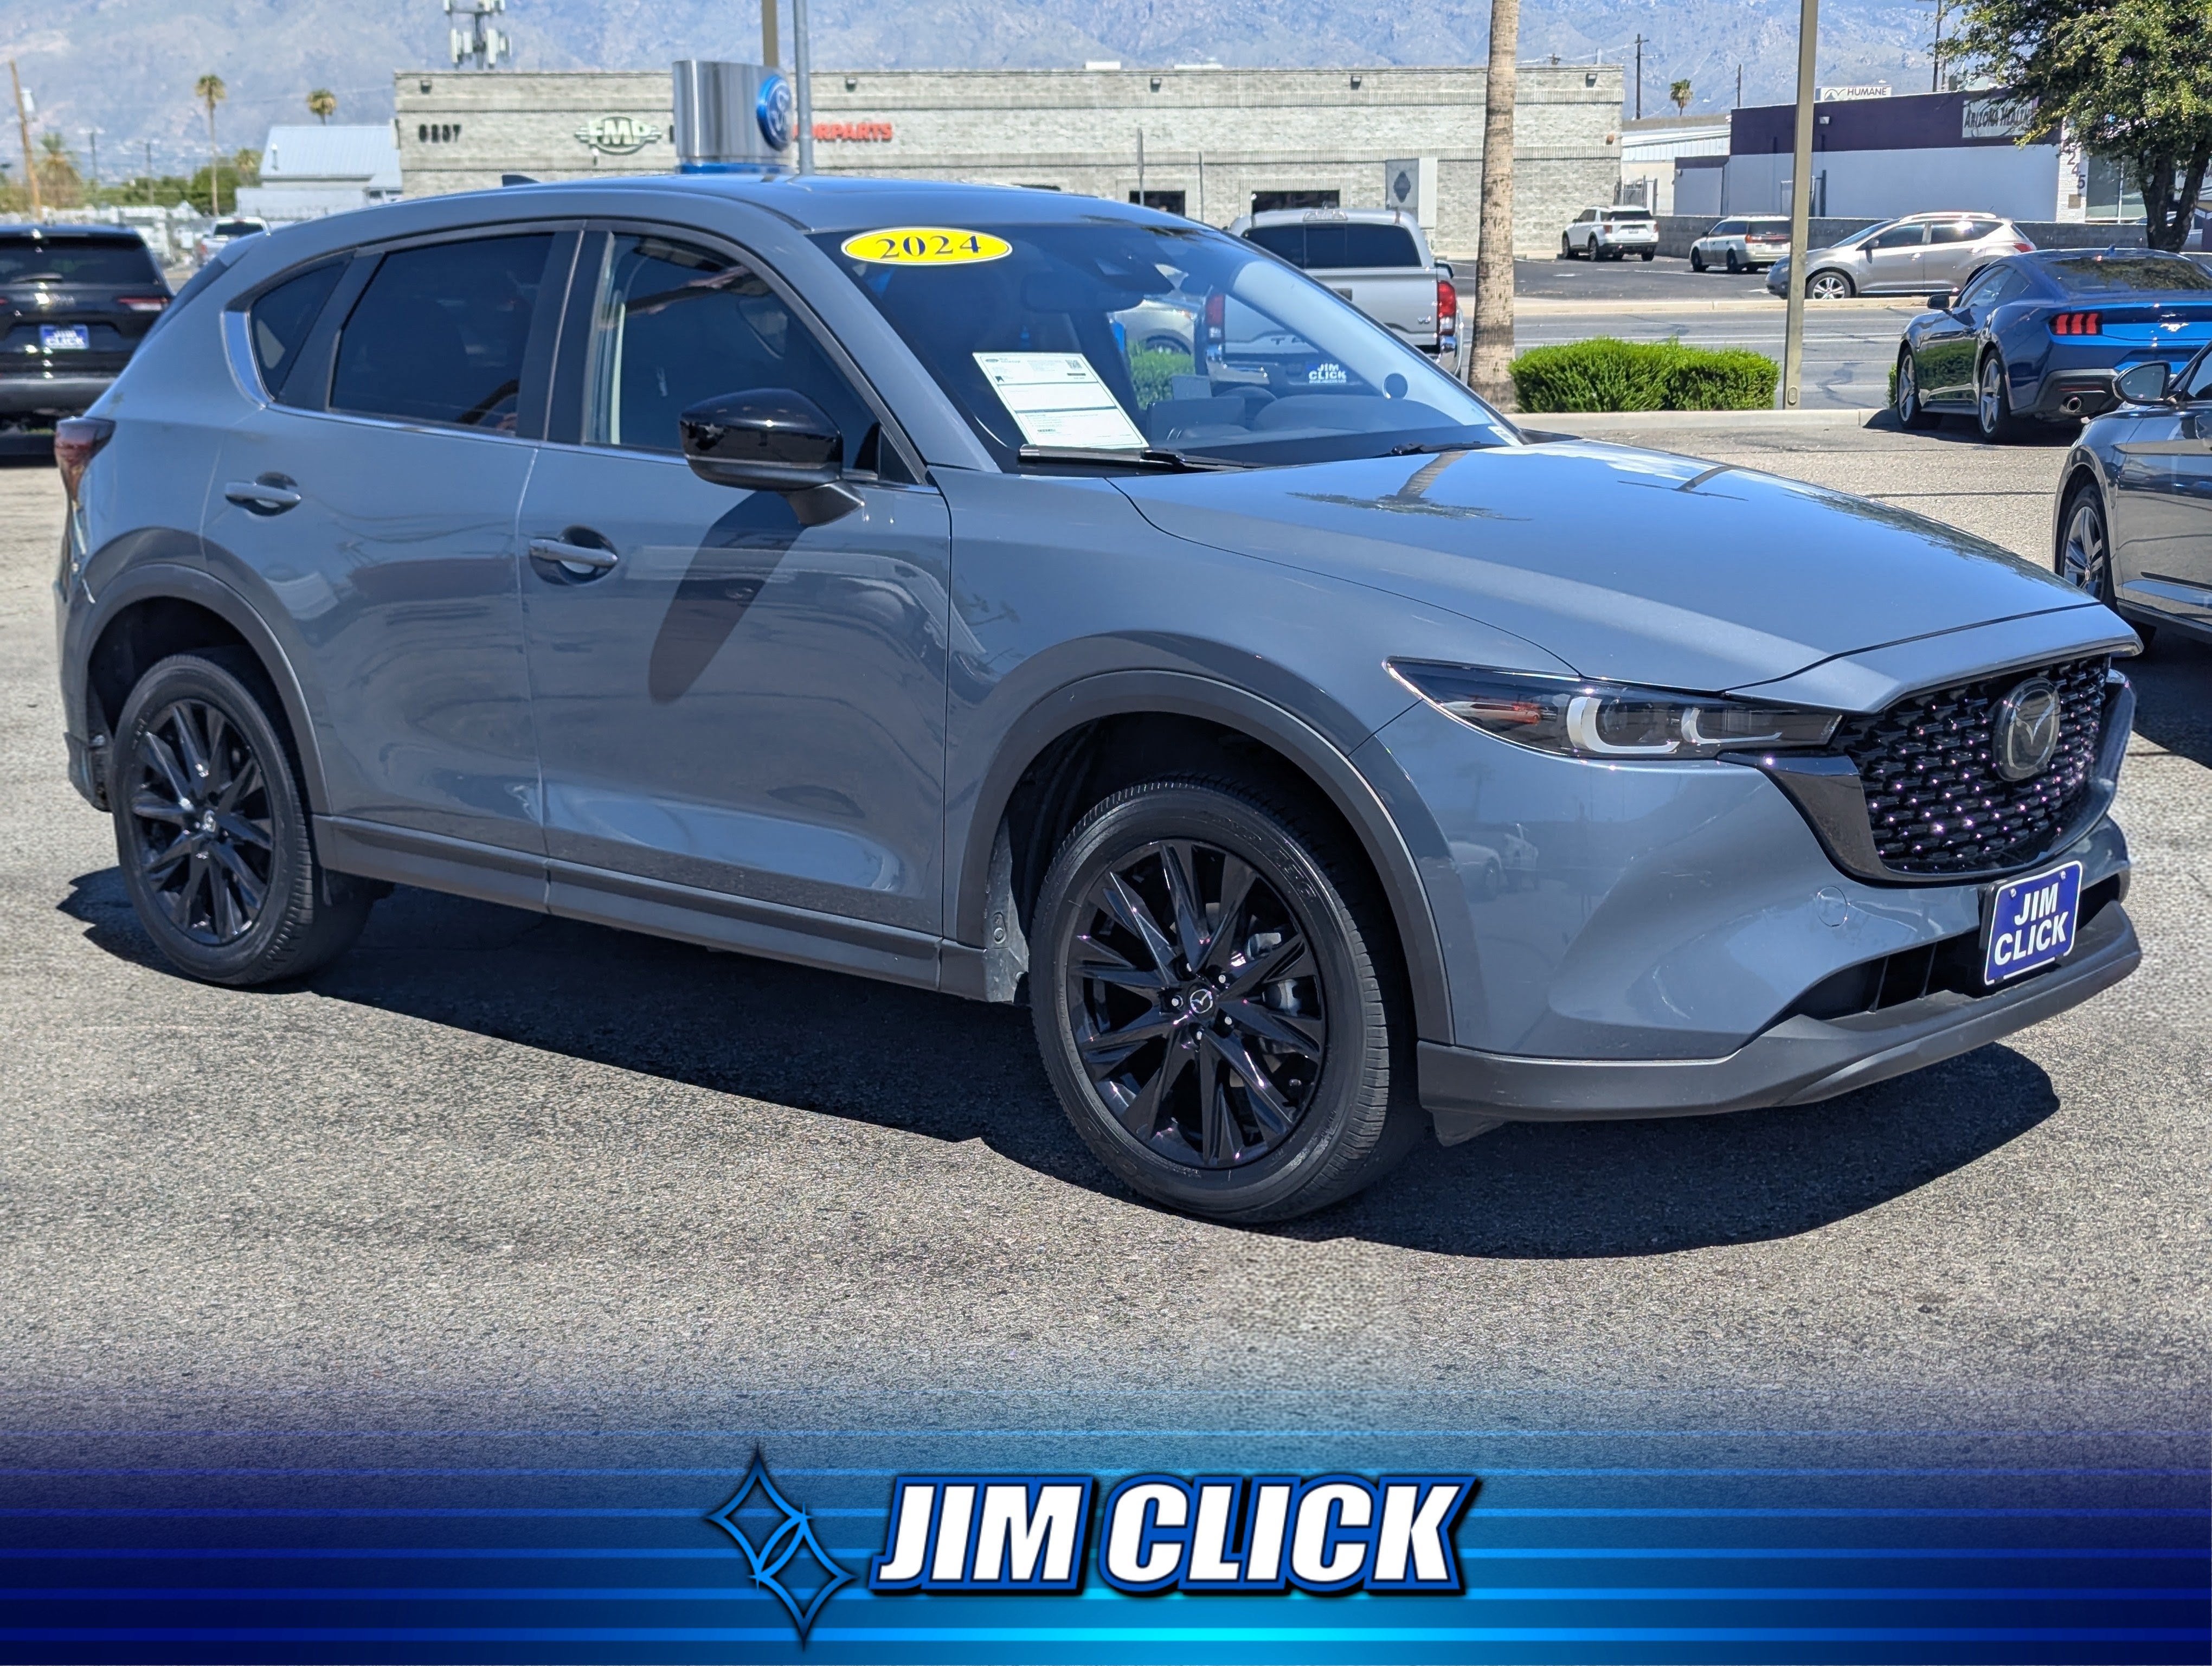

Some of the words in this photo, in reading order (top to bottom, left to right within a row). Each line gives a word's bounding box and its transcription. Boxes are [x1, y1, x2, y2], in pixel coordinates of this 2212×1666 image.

[1847, 87, 1887, 96] HUMANE
[876, 235, 982, 260] 2024
[1308, 370, 1347, 380] CLICK
[1317, 363, 1339, 371] JIM
[2014, 882, 2059, 926] JIM
[1994, 911, 2069, 965] CLICK
